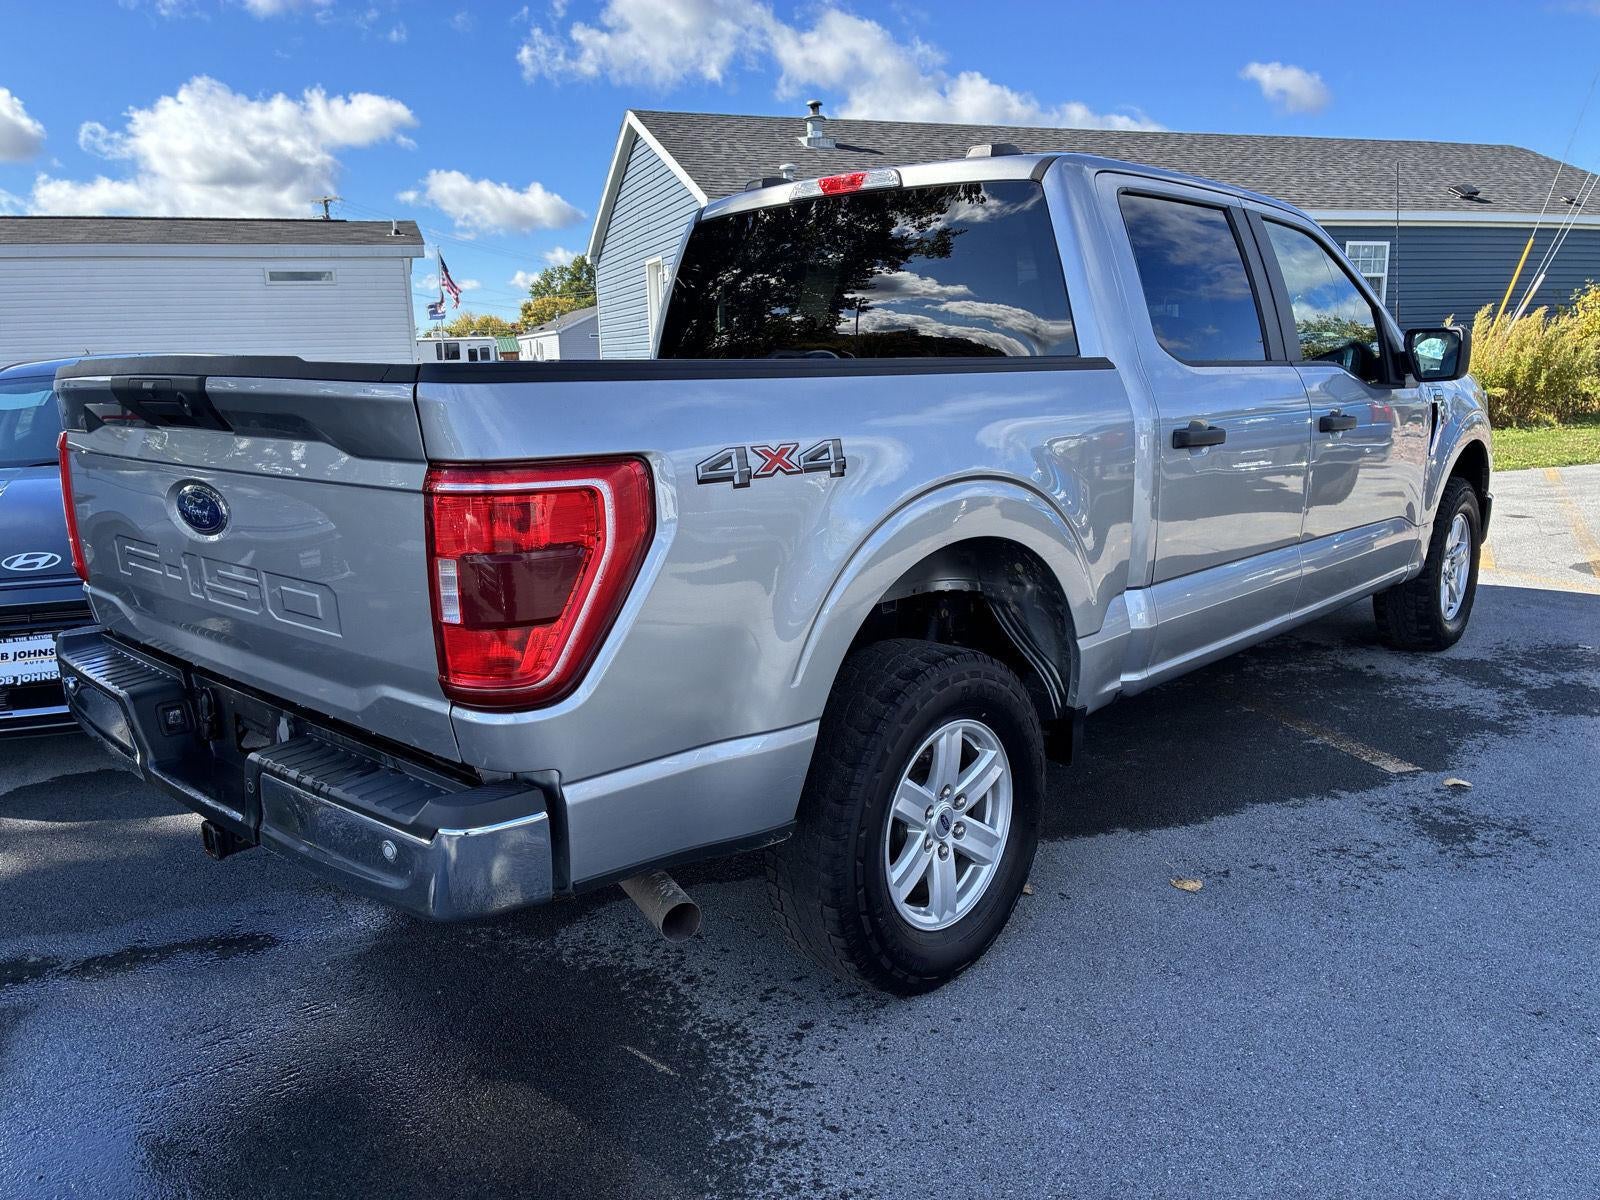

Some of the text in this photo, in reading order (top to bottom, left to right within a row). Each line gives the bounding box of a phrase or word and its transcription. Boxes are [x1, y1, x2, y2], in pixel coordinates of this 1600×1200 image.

[696, 439, 846, 489] 4X4
[114, 534, 342, 638] F-150
[29, 633, 53, 641] NATION
